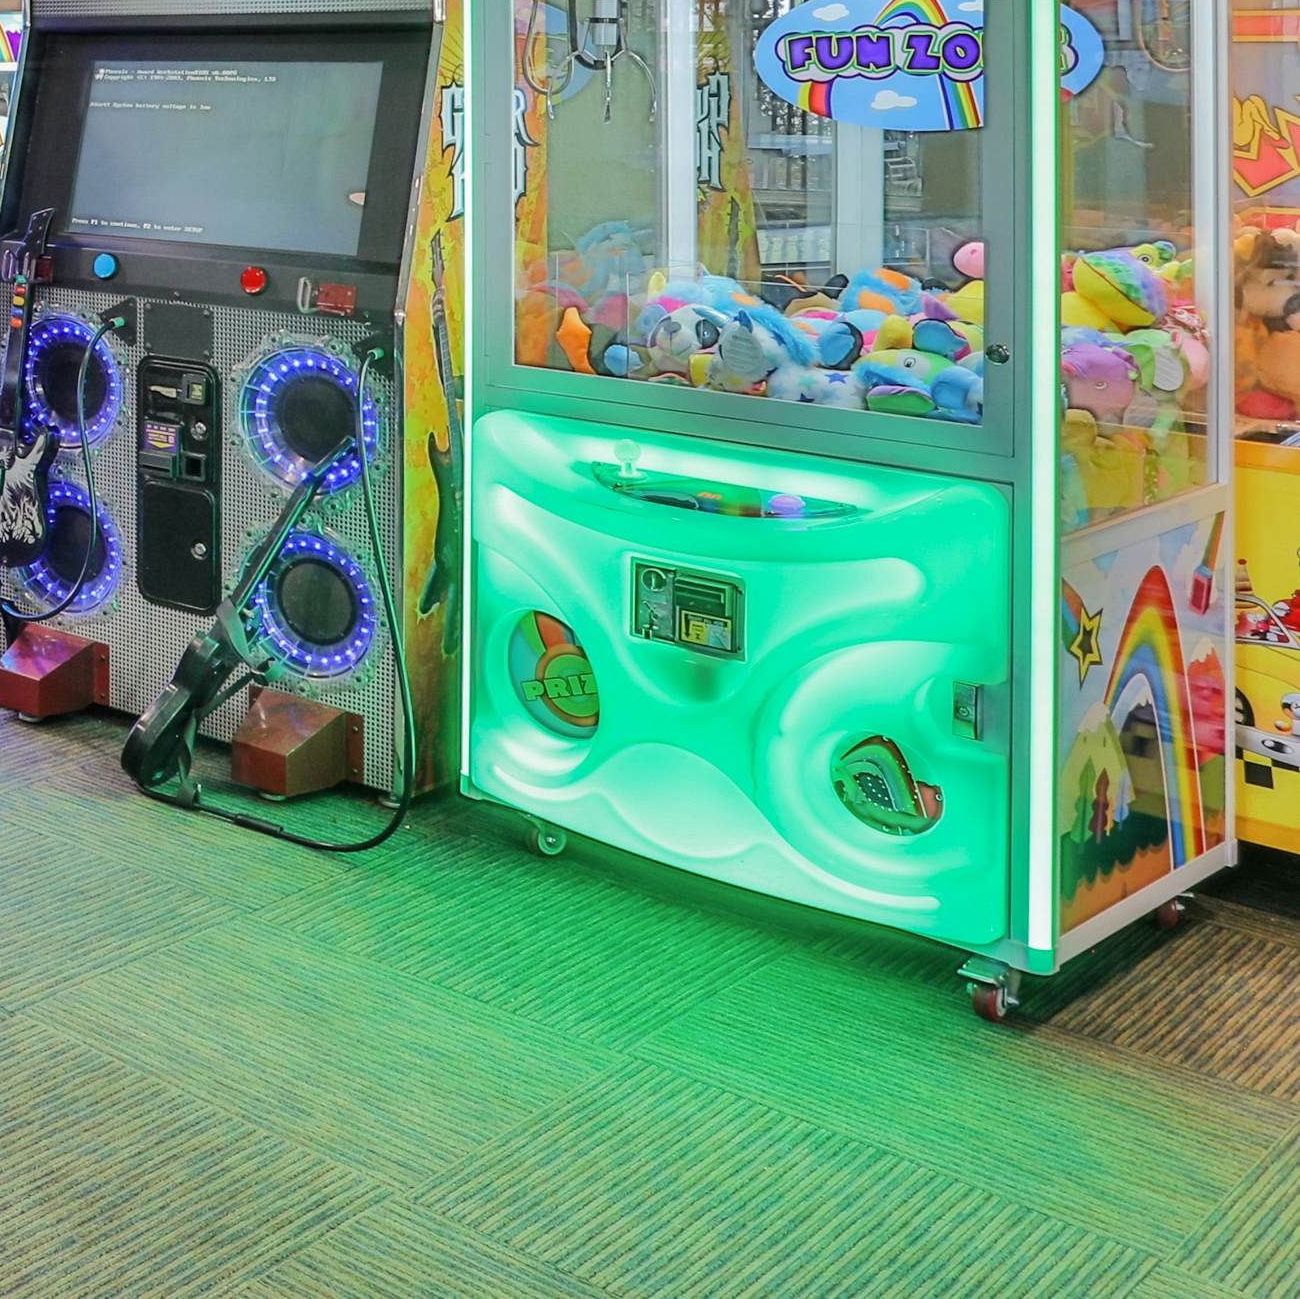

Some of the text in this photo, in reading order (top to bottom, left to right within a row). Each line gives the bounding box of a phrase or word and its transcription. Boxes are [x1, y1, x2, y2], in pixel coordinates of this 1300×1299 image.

[788, 34, 983, 70] FUN ZO
[521, 673, 598, 701] PRIZ
